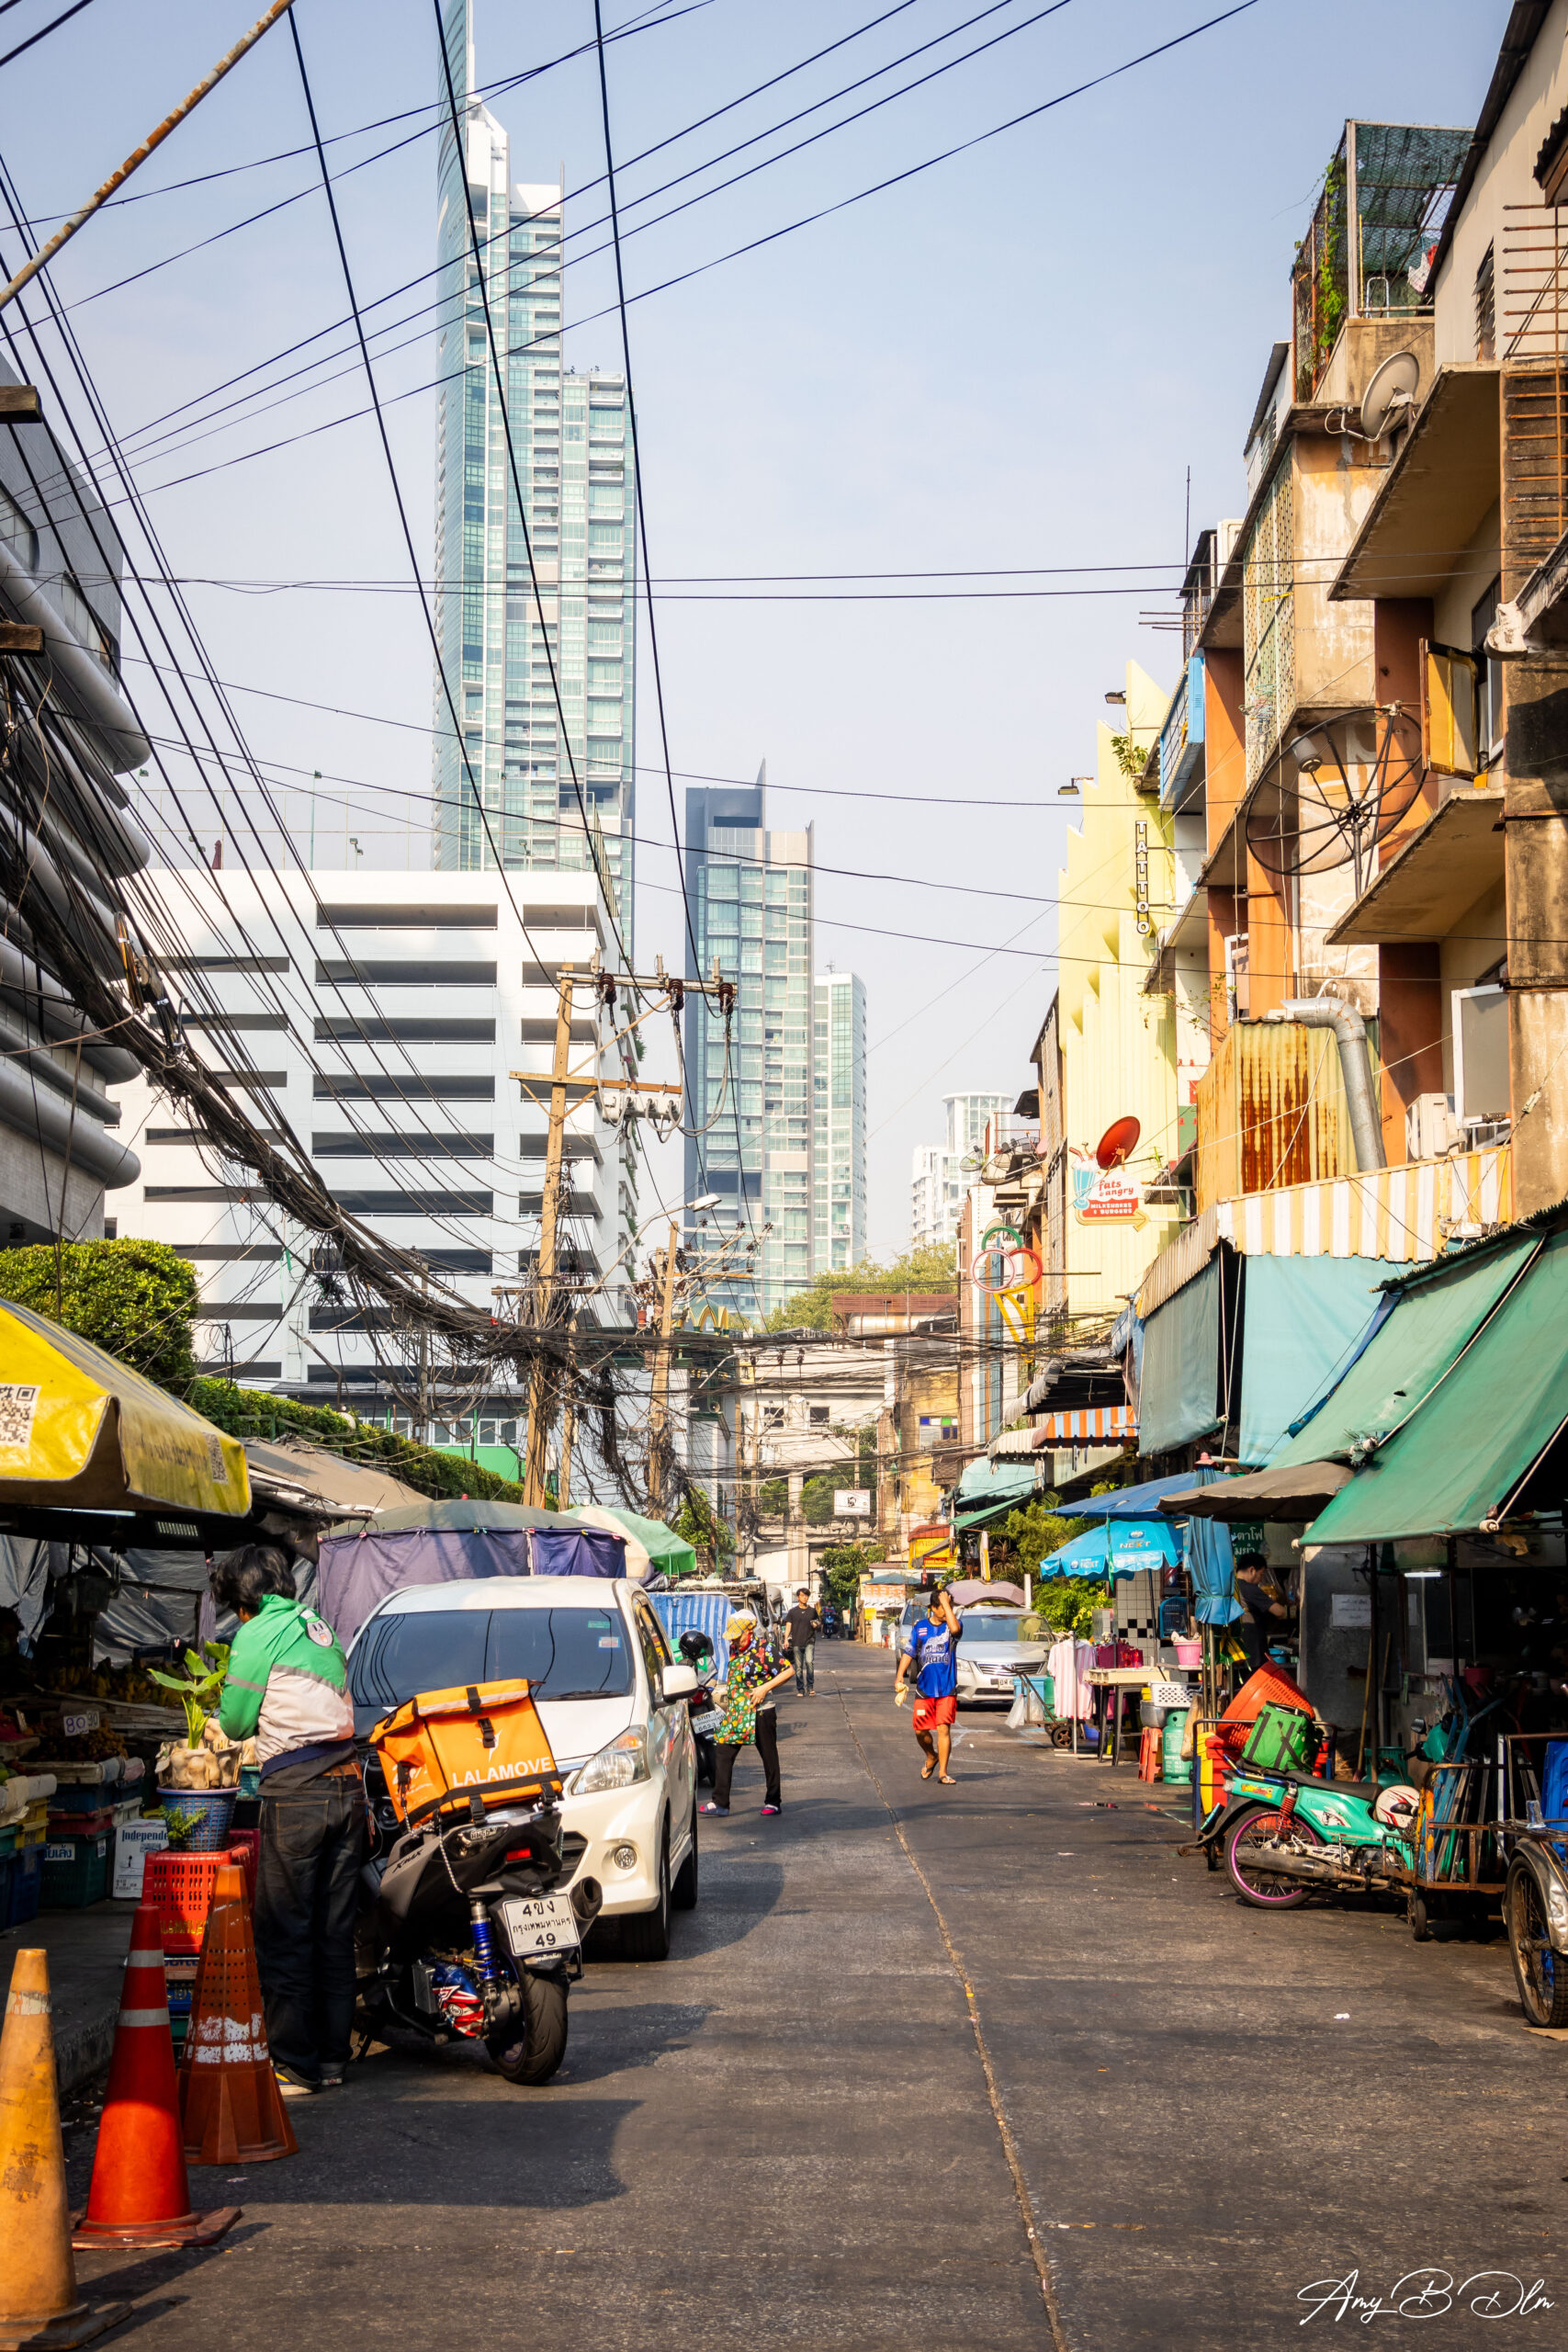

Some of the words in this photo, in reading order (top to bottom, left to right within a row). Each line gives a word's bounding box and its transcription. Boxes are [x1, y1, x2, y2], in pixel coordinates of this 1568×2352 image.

[1135, 820, 1150, 933] TATTOO
[1099, 1180, 1122, 1192] fats
[1105, 1187, 1134, 1196] angry
[1119, 1541, 1151, 1549] NEXT
[66, 1717, 86, 1733] 80
[87, 1712, 98, 1726] 90
[452, 1757, 552, 1788] LALAMOVE
[513, 1917, 571, 1935] กรุงเทพมหานคร
[536, 1932, 557, 1947] 49
